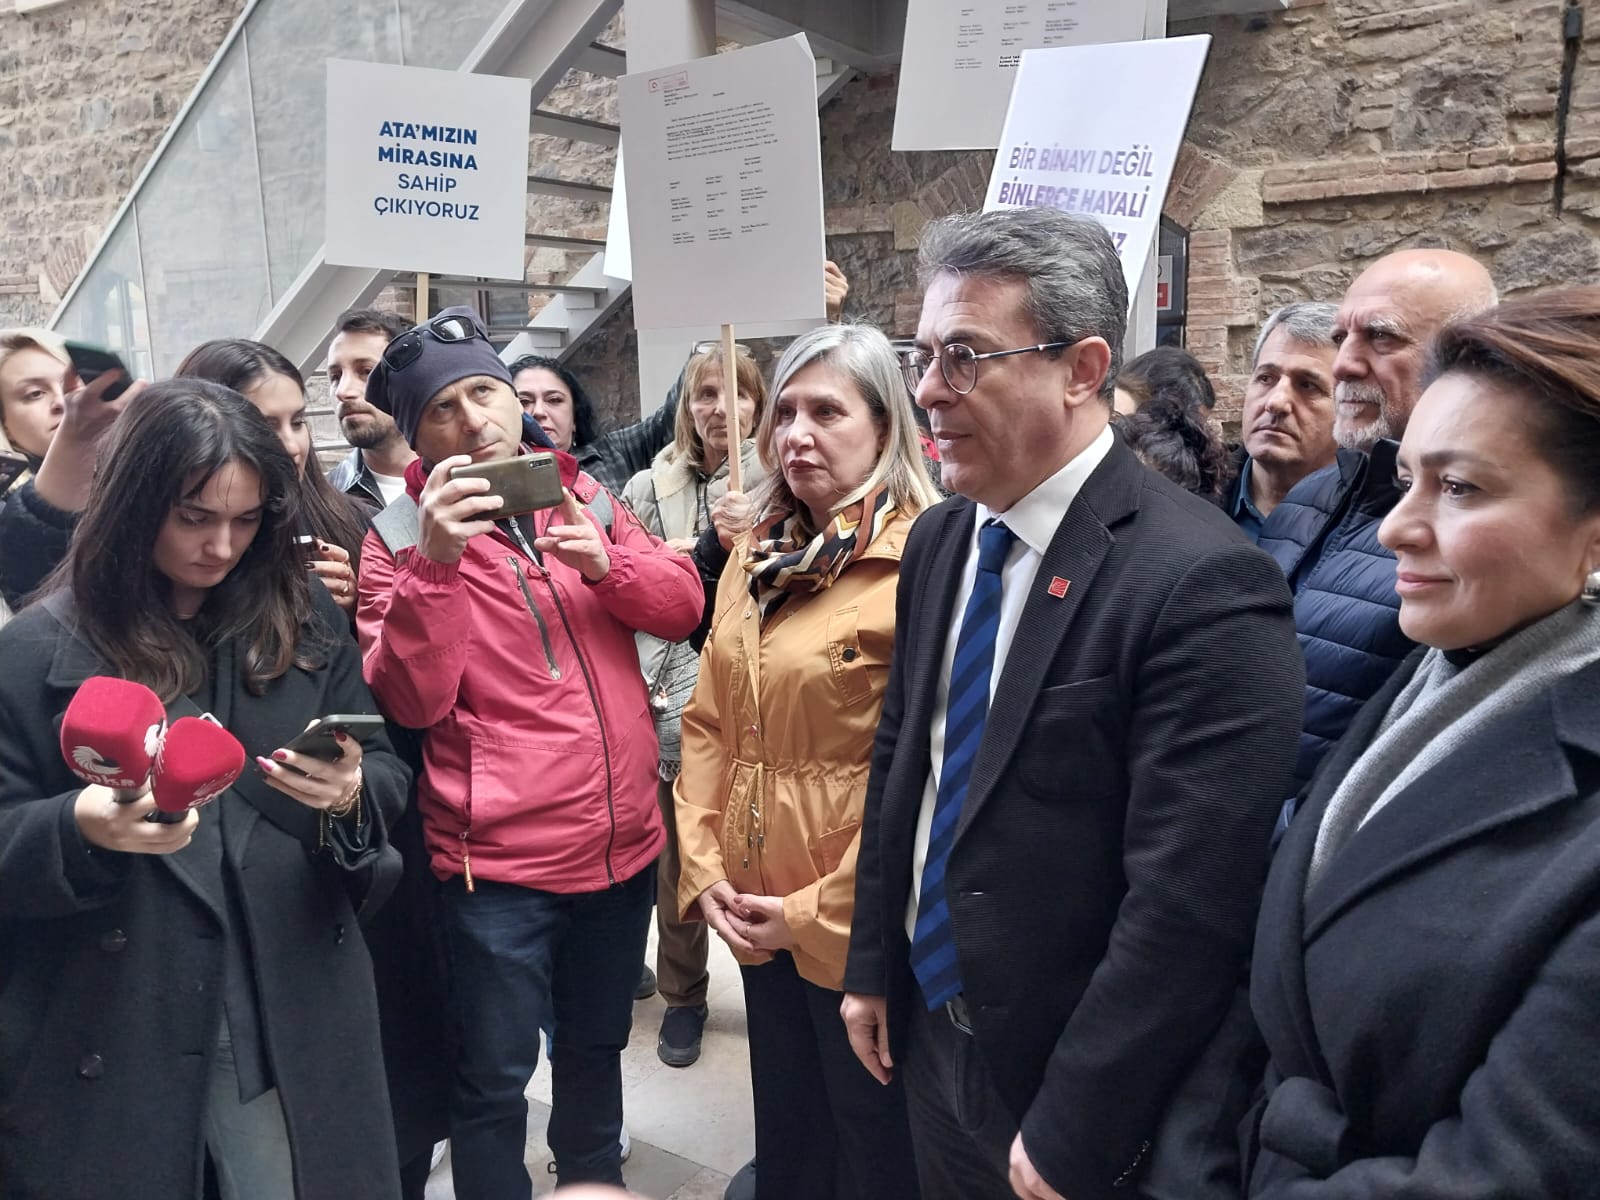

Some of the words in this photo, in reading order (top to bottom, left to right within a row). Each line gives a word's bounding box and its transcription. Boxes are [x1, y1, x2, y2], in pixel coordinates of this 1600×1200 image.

[379, 121, 477, 145] ATA’MIZIN
[378, 142, 478, 170] MİRASINA
[1009, 142, 1036, 170] BİR
[1038, 143, 1096, 174] BİNAYI
[1098, 144, 1153, 177] DEĞİL
[398, 173, 457, 193] SAHİP
[374, 196, 480, 220] ÇIKIYORUZ
[999, 176, 1079, 212] BİNLERCE
[1080, 185, 1150, 218] HAYALİ
